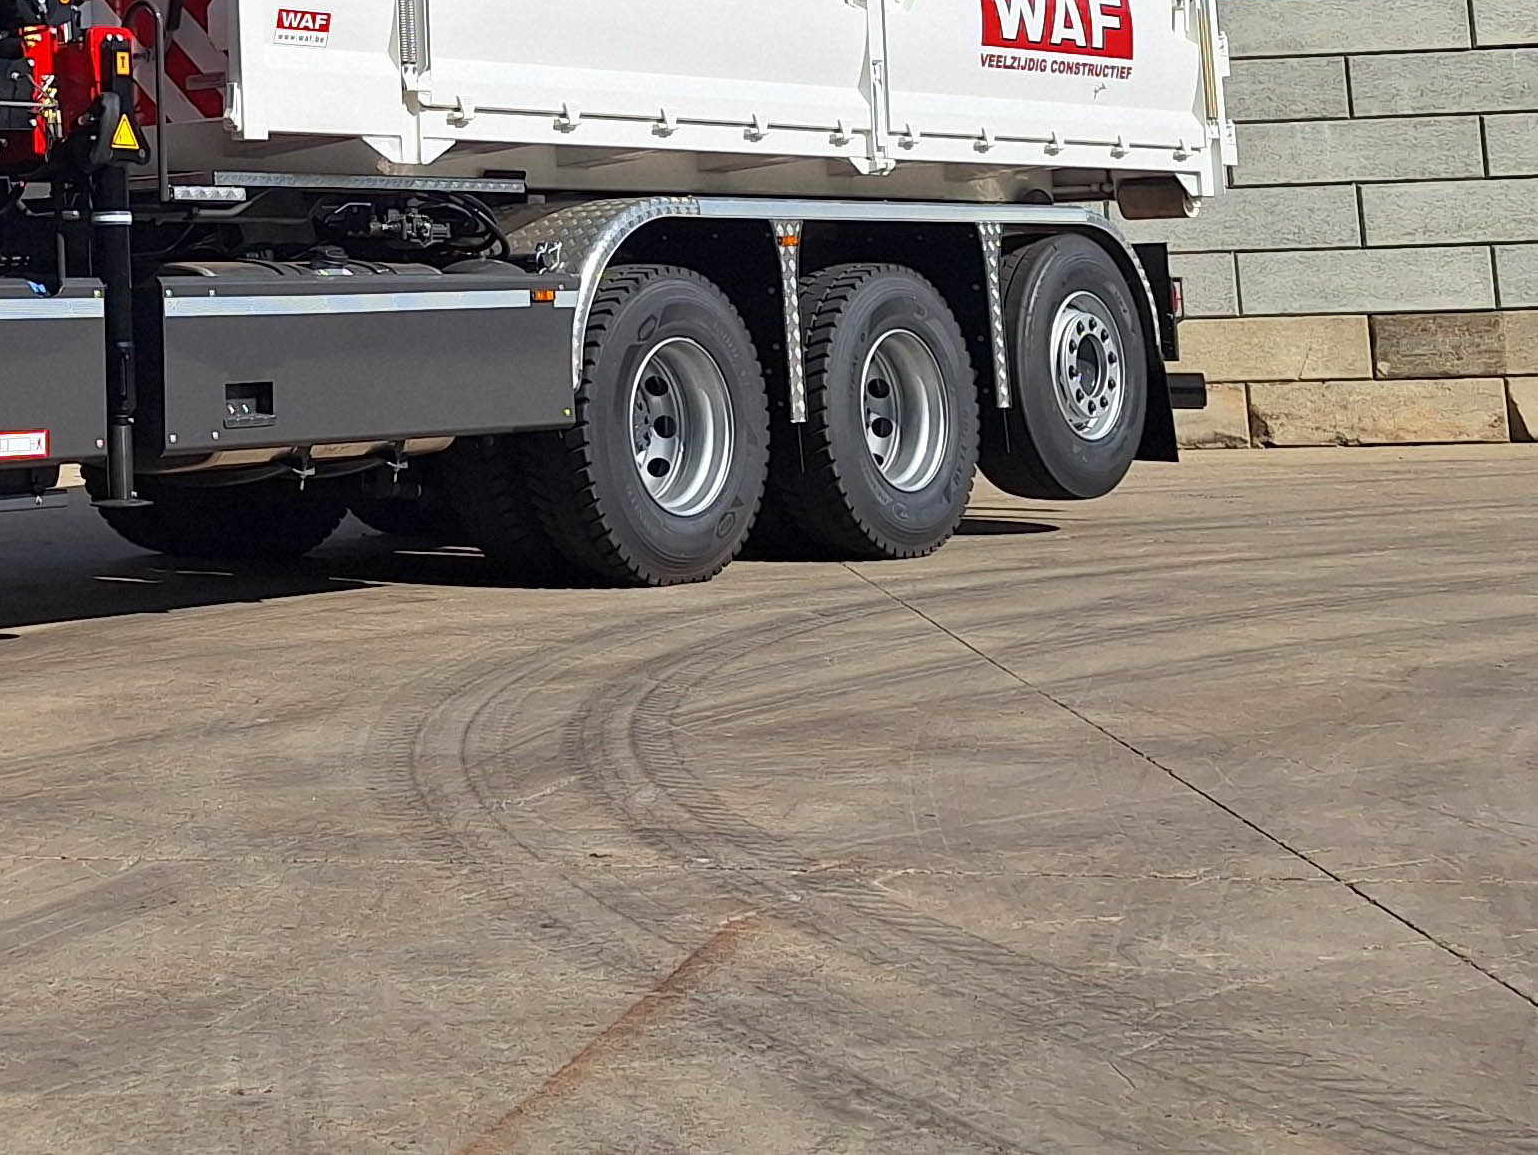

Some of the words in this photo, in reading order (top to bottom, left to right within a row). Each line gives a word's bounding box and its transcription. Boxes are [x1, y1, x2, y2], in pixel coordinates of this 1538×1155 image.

[281, 11, 328, 30] WAF
[980, 52, 1048, 73] VEELZIJDIG
[1050, 58, 1133, 81] CONSTRUCTIEF
